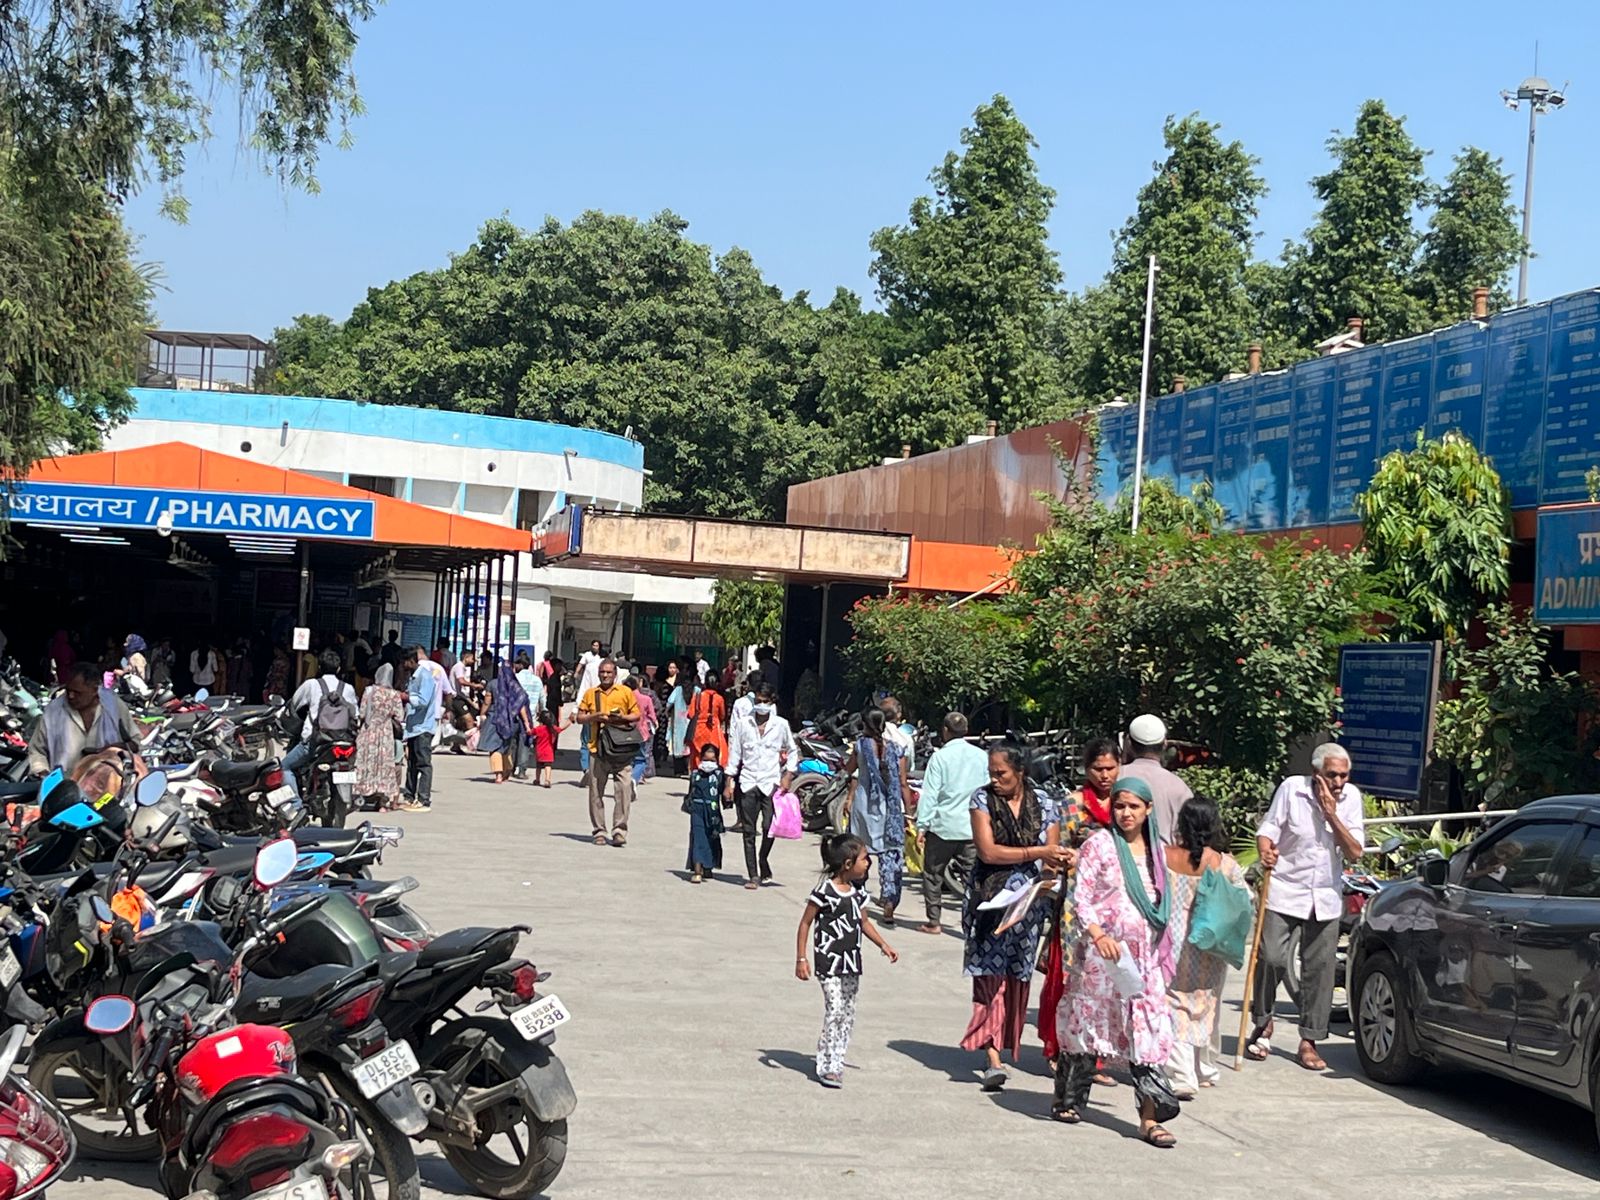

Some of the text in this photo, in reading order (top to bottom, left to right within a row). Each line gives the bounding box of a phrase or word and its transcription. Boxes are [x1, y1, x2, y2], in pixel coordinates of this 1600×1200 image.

[1, 490, 137, 520] षधालय
[169, 499, 363, 532] PHARMACY
[525, 1009, 564, 1034] 5238
[364, 1046, 405, 1078] DL8SC
